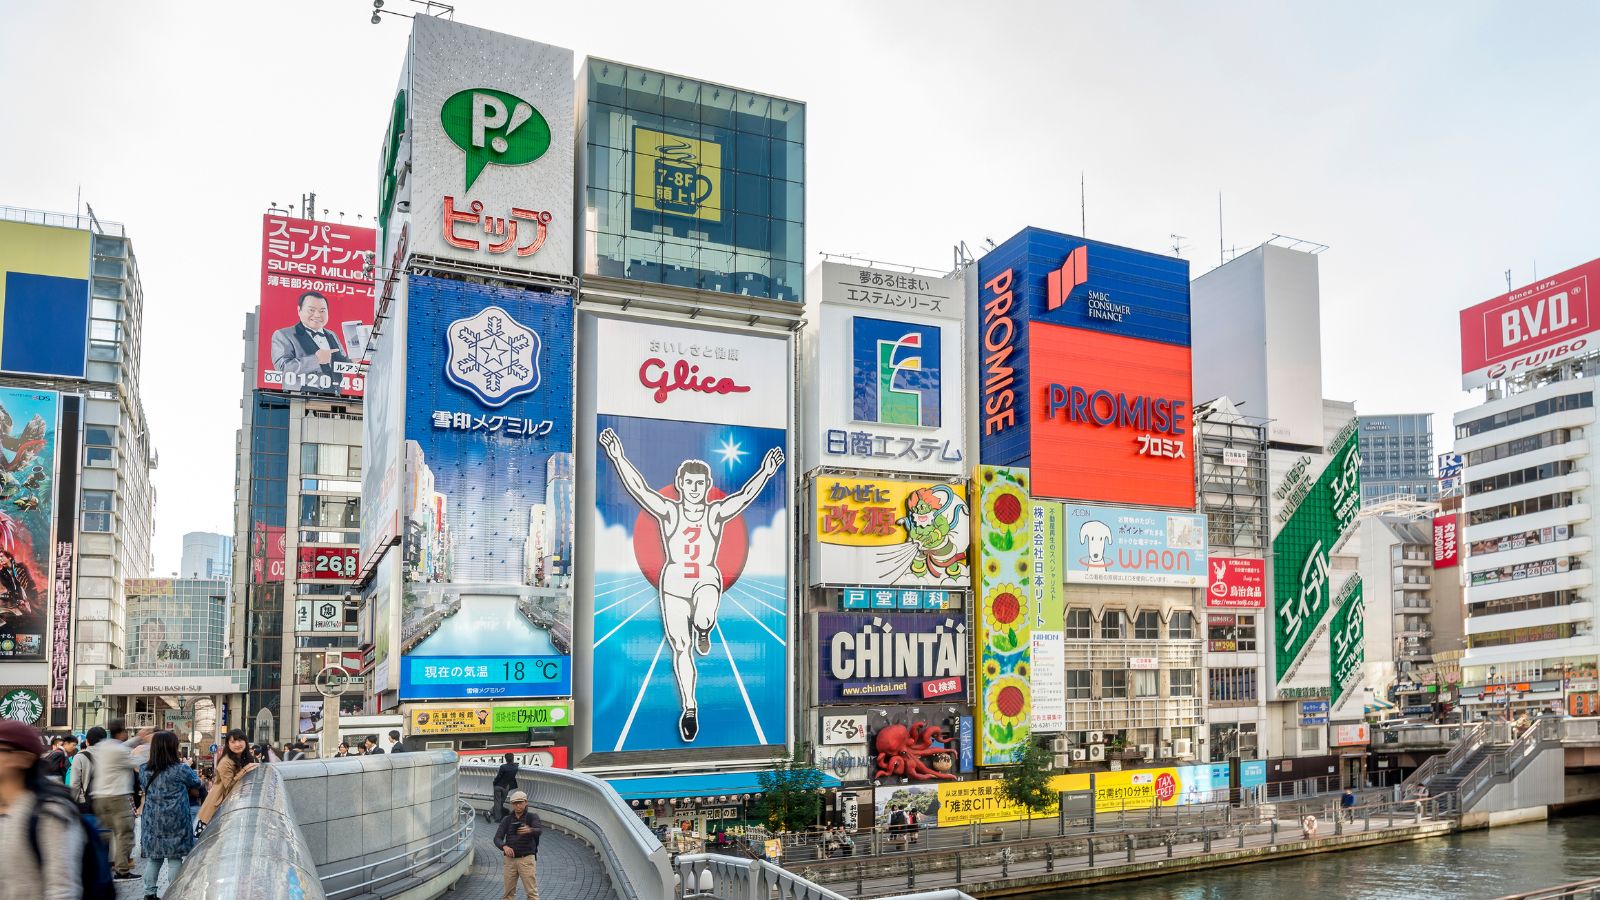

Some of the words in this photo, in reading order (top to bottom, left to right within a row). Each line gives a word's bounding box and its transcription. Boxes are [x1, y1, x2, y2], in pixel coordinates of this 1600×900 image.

[471, 92, 533, 153] P!
[269, 219, 350, 243] スーパー
[443, 195, 552, 256] ピップ
[268, 260, 317, 275] SUPER
[859, 270, 930, 291] 夢ある住まい
[847, 289, 942, 312] エステムシリーズ
[1088, 299, 1131, 315] CONSUMER
[1089, 290, 1110, 301] SMBC
[1088, 309, 1123, 322] FINANCE
[1501, 291, 1578, 348] B.V.D.
[650, 340, 739, 361] おいしさと健康
[984, 268, 1014, 436] PROMISE
[1511, 339, 1587, 372] FUJIBO
[639, 358, 751, 403] Glico
[1049, 383, 1185, 434] PROMISE
[432, 410, 553, 436] 雪印メグミルク
[827, 429, 962, 462] 日商エステム
[1137, 434, 1185, 458] プロミス
[1330, 444, 1363, 510] エイブル
[830, 482, 891, 503] かぜに
[823, 504, 897, 536] 改源
[682, 524, 702, 578] グリコ
[1444, 523, 1456, 559] カラオケ
[316, 556, 356, 571] 268
[1033, 506, 1045, 627] 株式会社日本リート
[1118, 548, 1190, 571] WAON
[849, 591, 943, 606] 戸堂歯科
[1280, 540, 1332, 652] エイブル
[1334, 596, 1365, 664] エイブル
[424, 665, 489, 678] 現在の気温
[503, 661, 525, 681] 18
[466, 687, 506, 695] 雪印メグミルク
[1157, 776, 1172, 788] TAX
